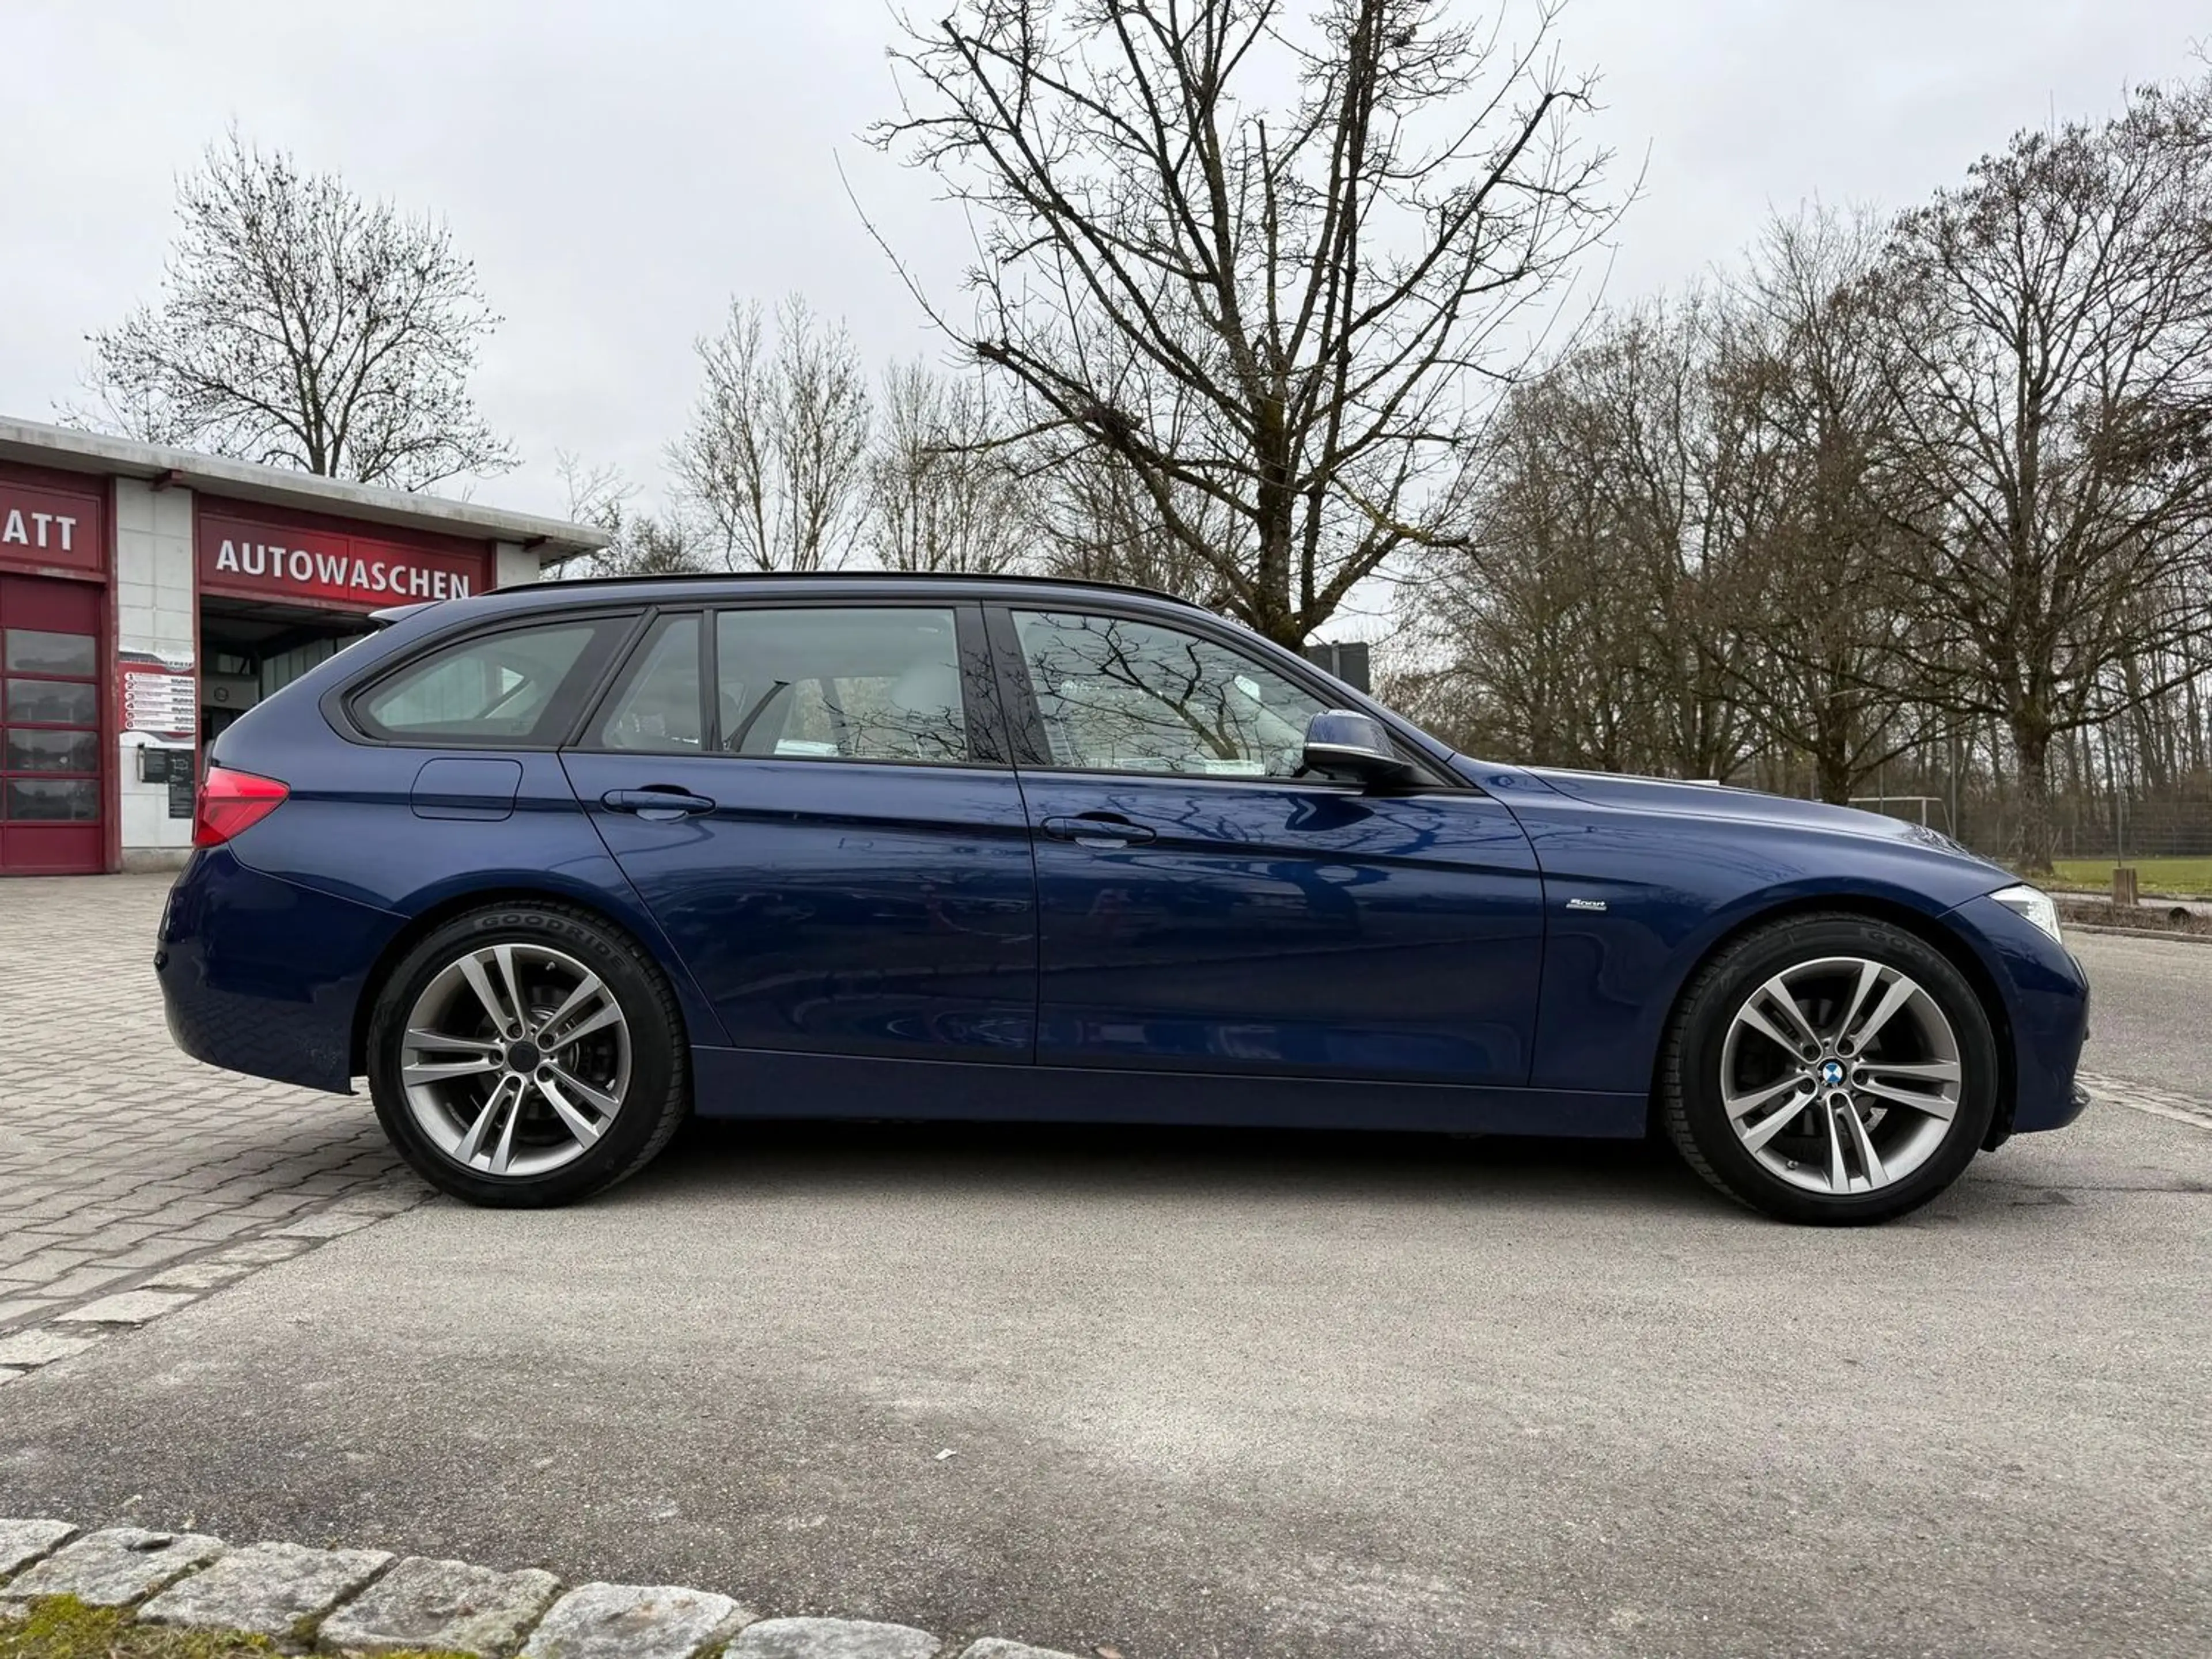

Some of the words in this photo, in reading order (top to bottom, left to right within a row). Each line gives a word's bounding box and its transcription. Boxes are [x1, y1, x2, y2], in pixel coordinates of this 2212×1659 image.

[2, 509, 77, 551] ATT
[215, 539, 469, 600] AUTOWASCHEN
[482, 914, 626, 969] GOODRIDE
